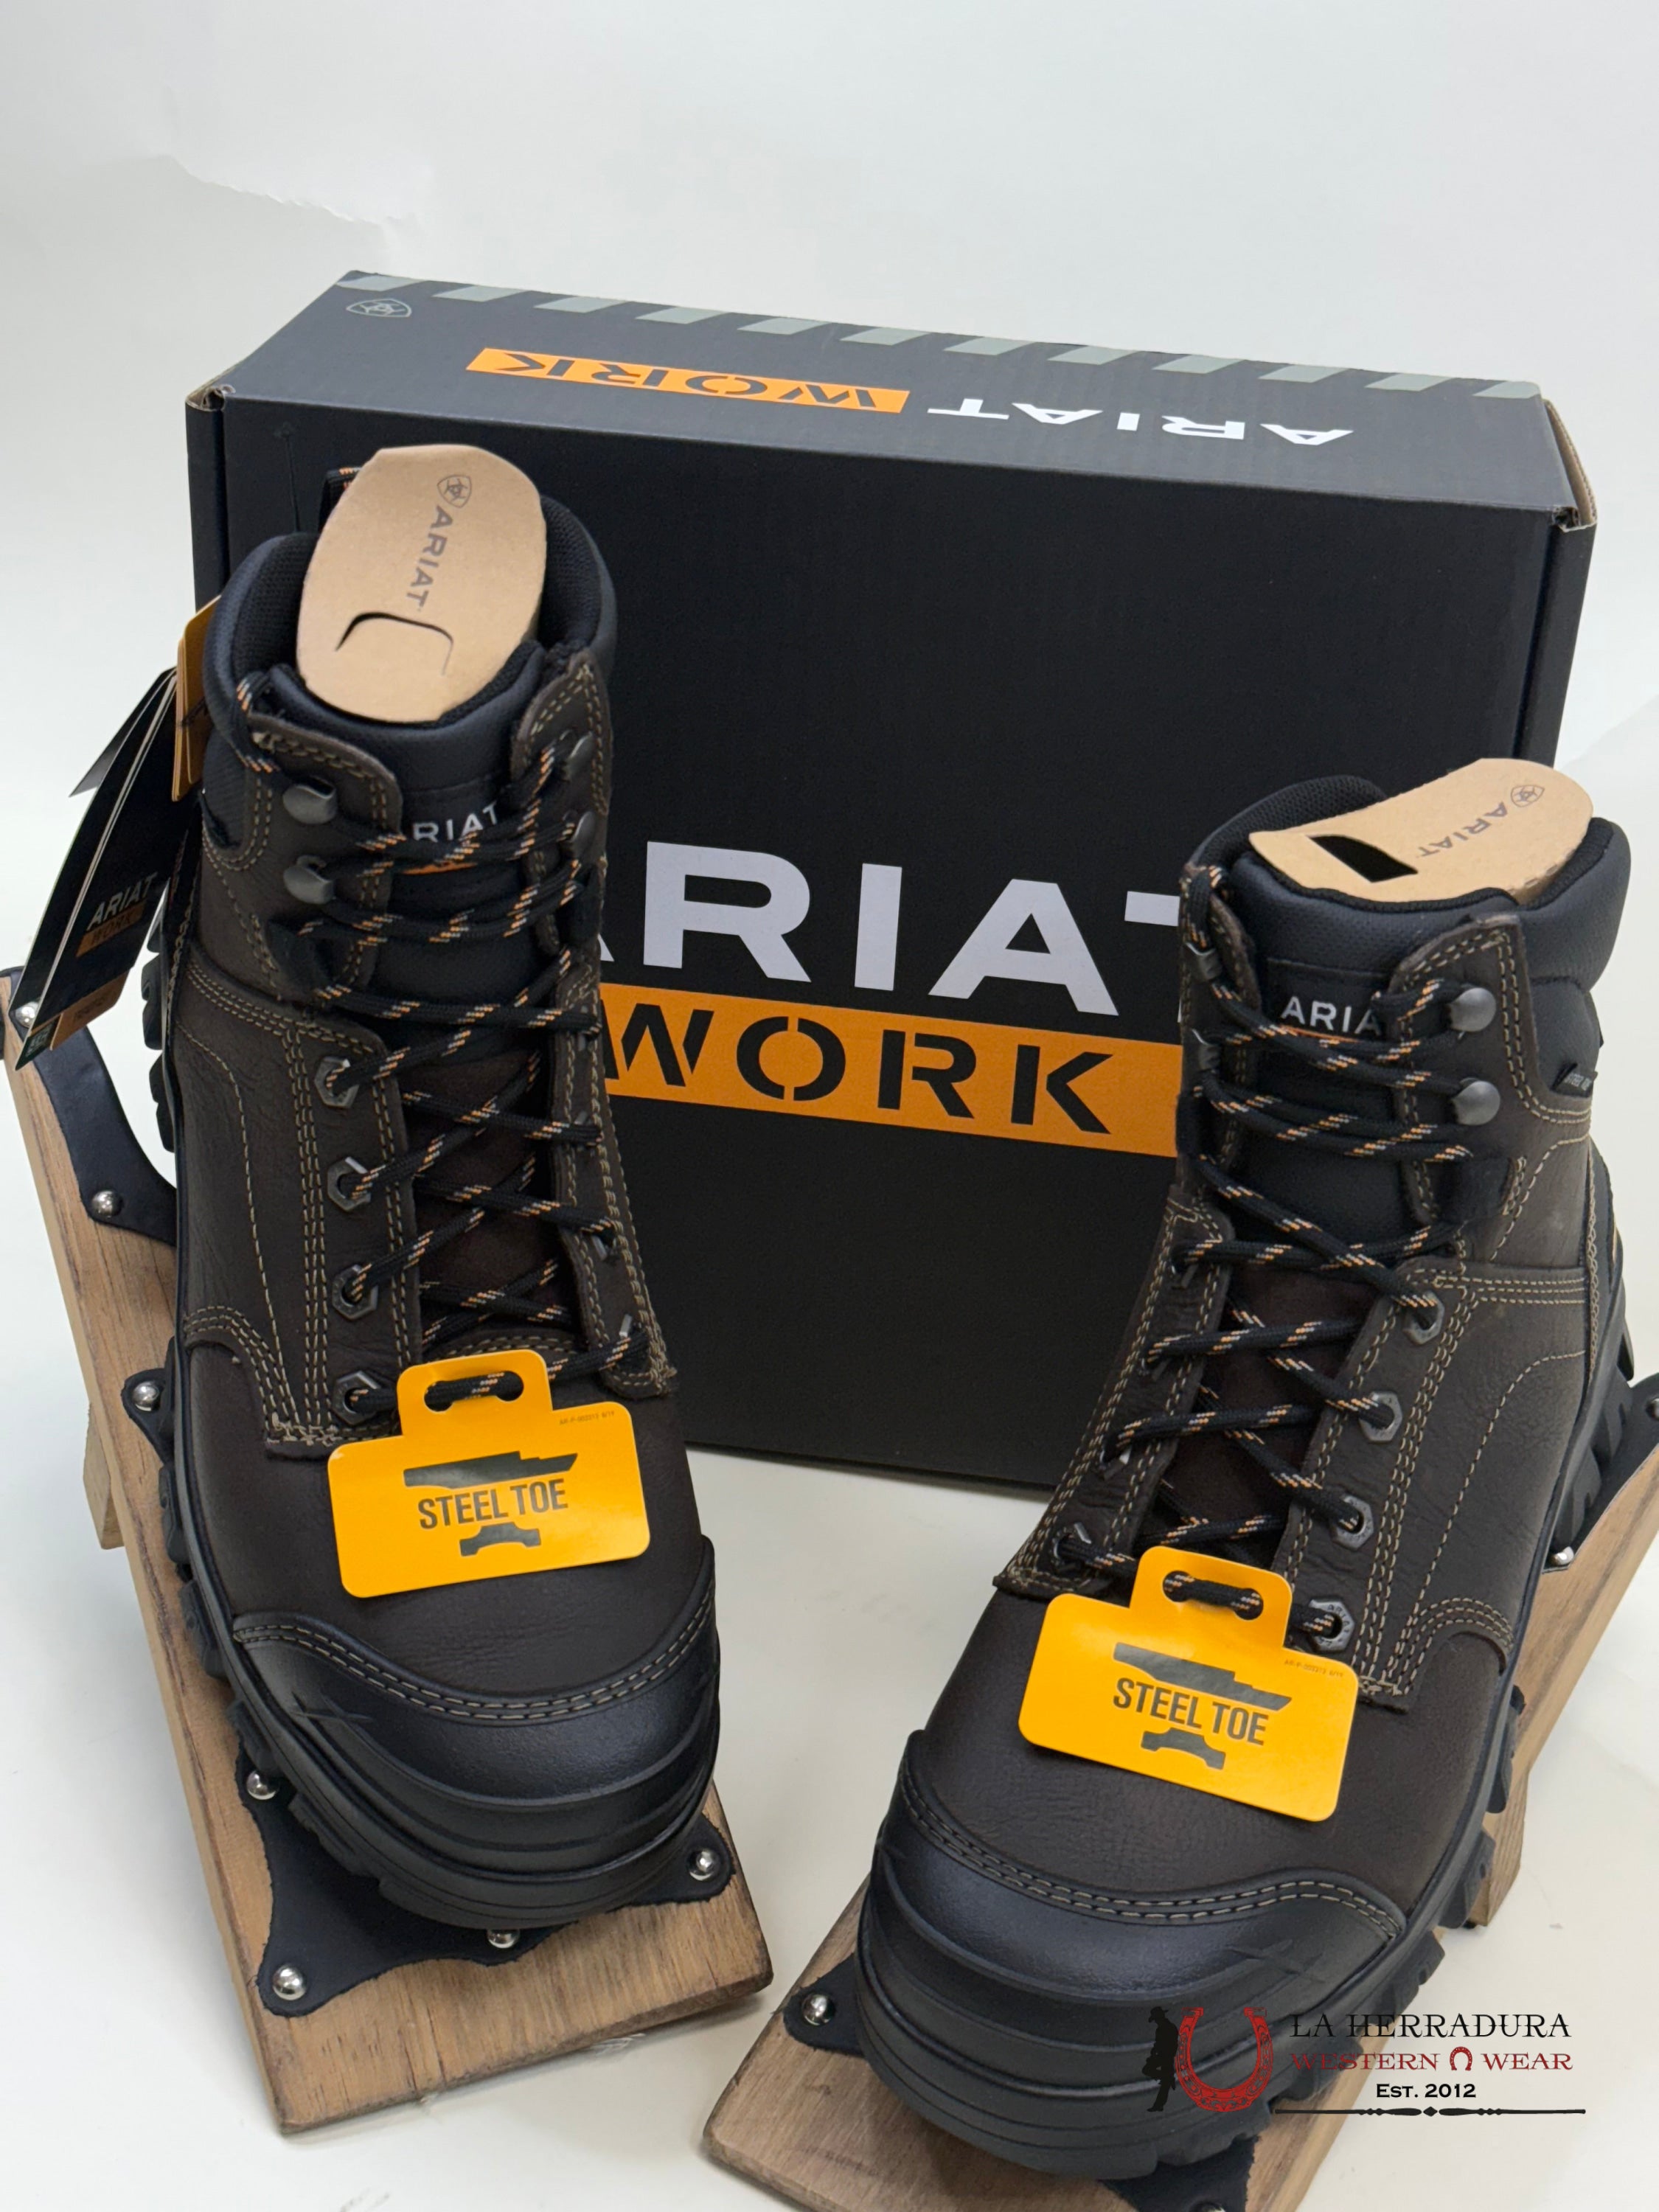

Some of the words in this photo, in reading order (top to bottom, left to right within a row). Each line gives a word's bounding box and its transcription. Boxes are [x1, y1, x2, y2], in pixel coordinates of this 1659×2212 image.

[497, 352, 877, 408] WORK
[927, 399, 1354, 445] ARIAT
[406, 505, 454, 611] ARIAT
[412, 801, 498, 843] RIAT
[1416, 801, 1509, 859] ARIAT
[86, 872, 158, 931] ARIAT
[598, 841, 1180, 1016] RIA
[1280, 995, 1382, 1036] ARIA
[599, 999, 1111, 1134] WORK
[418, 1489, 509, 1529] STEEL
[510, 1478, 568, 1515] TOE
[1113, 1677, 1202, 1729] STEEL
[1212, 1701, 1269, 1746] TOE
